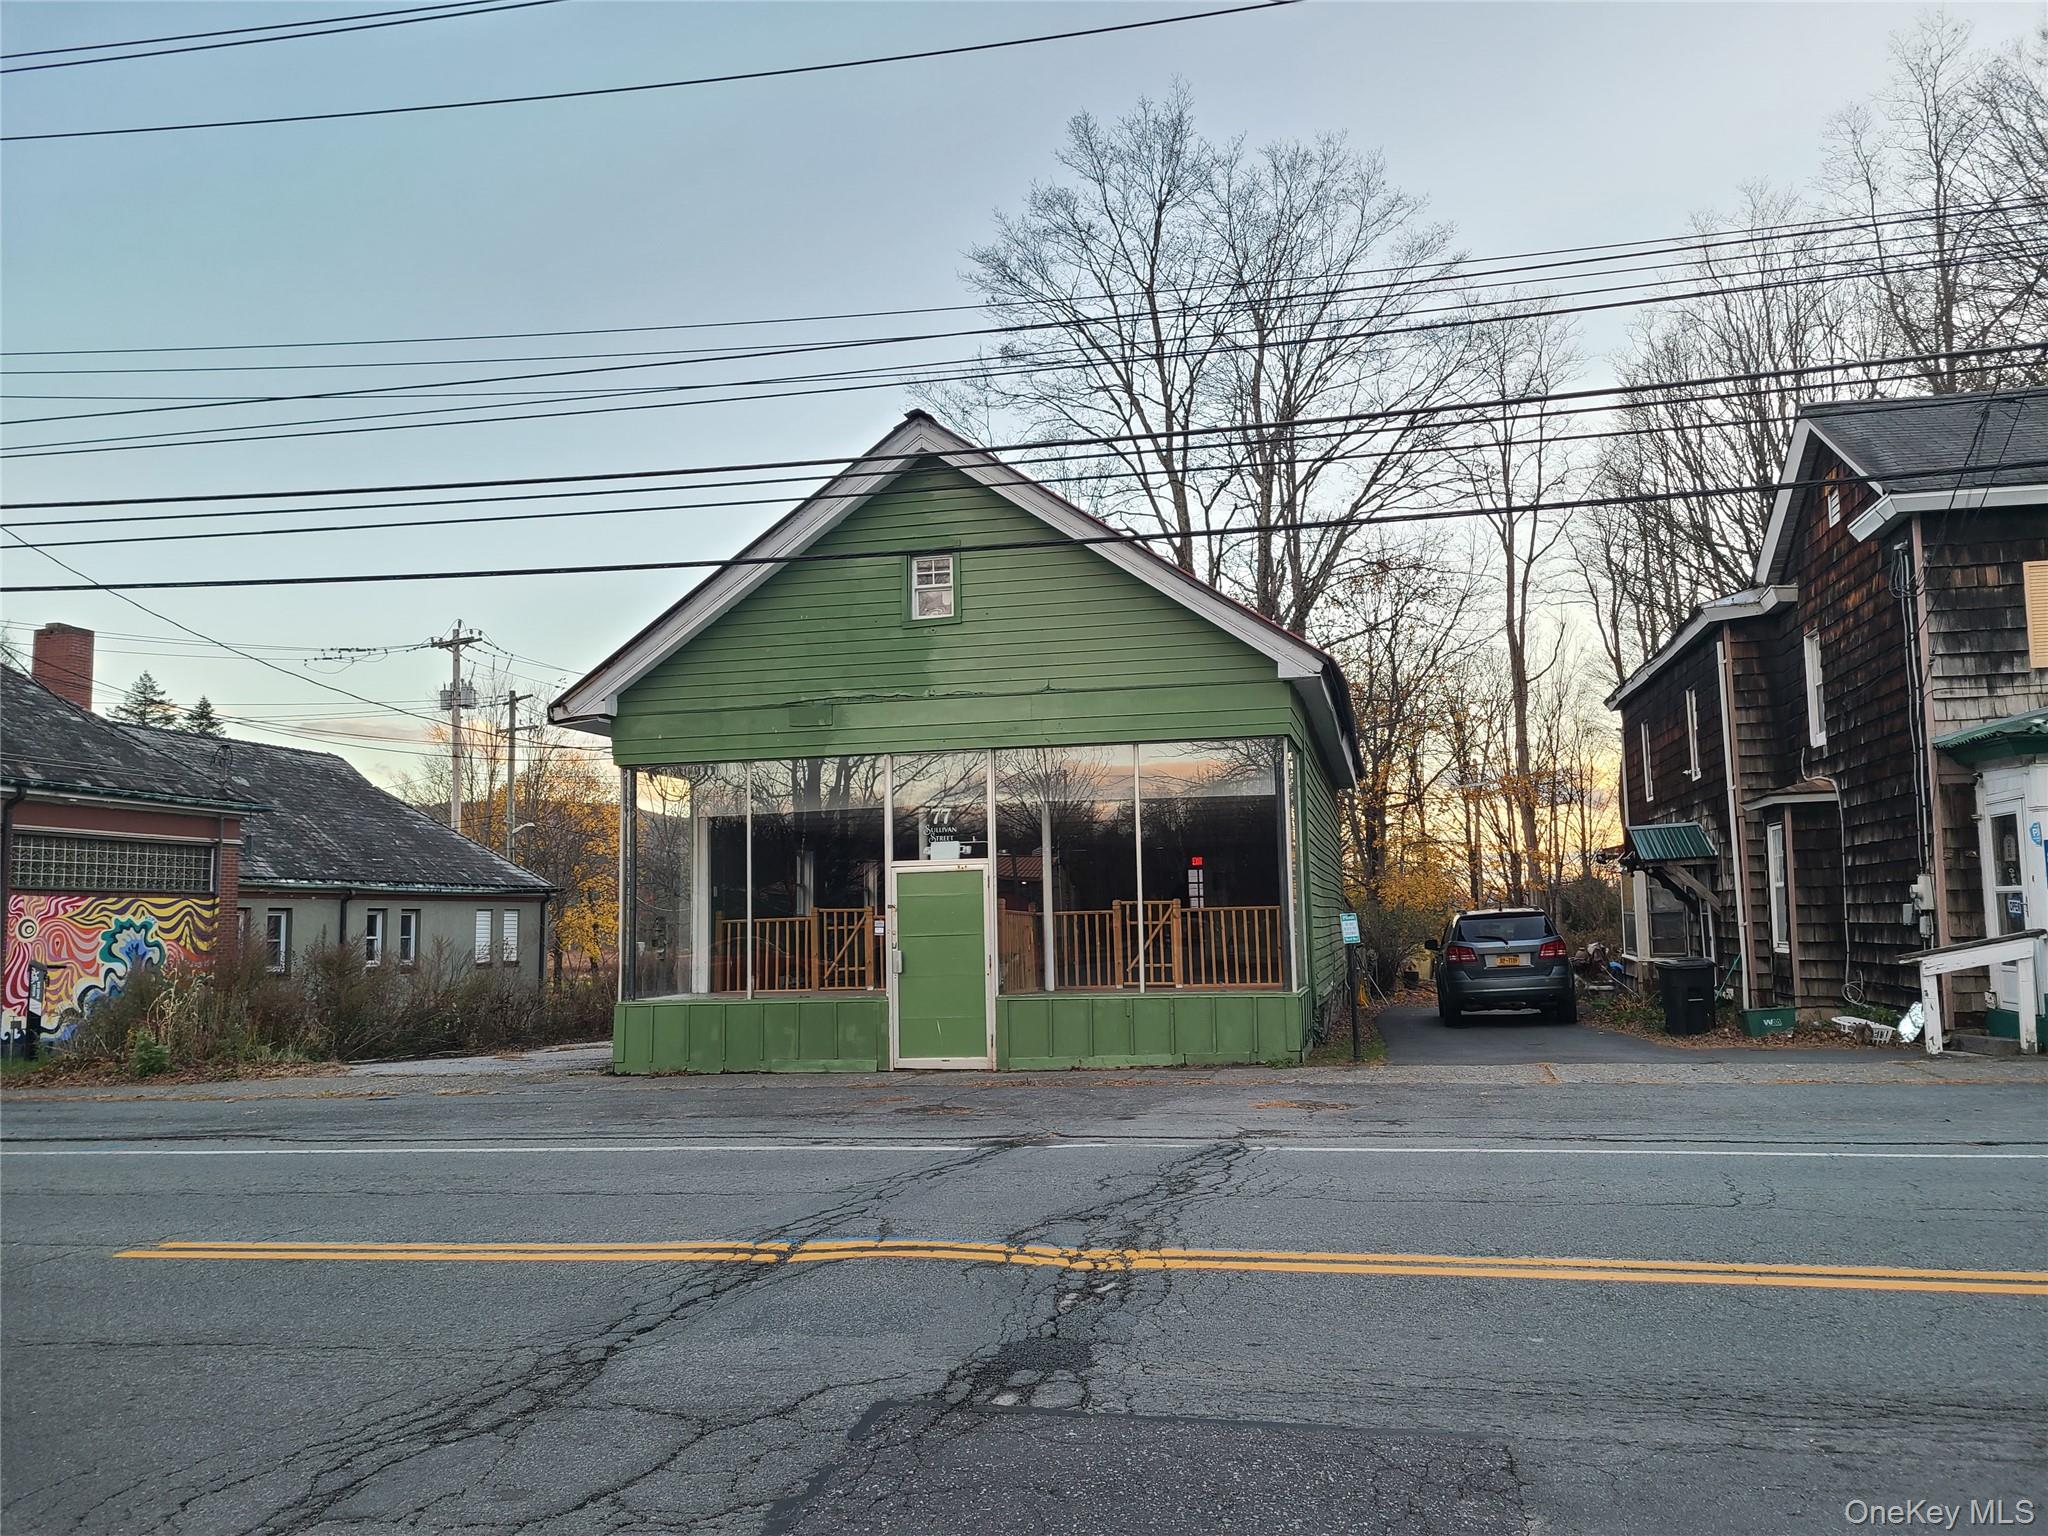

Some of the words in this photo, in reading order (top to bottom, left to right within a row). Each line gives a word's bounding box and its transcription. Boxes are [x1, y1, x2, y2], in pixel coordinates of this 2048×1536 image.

[930, 808, 952, 824] 77
[923, 824, 957, 836] SULLIVAN
[928, 832, 954, 844] STREET
